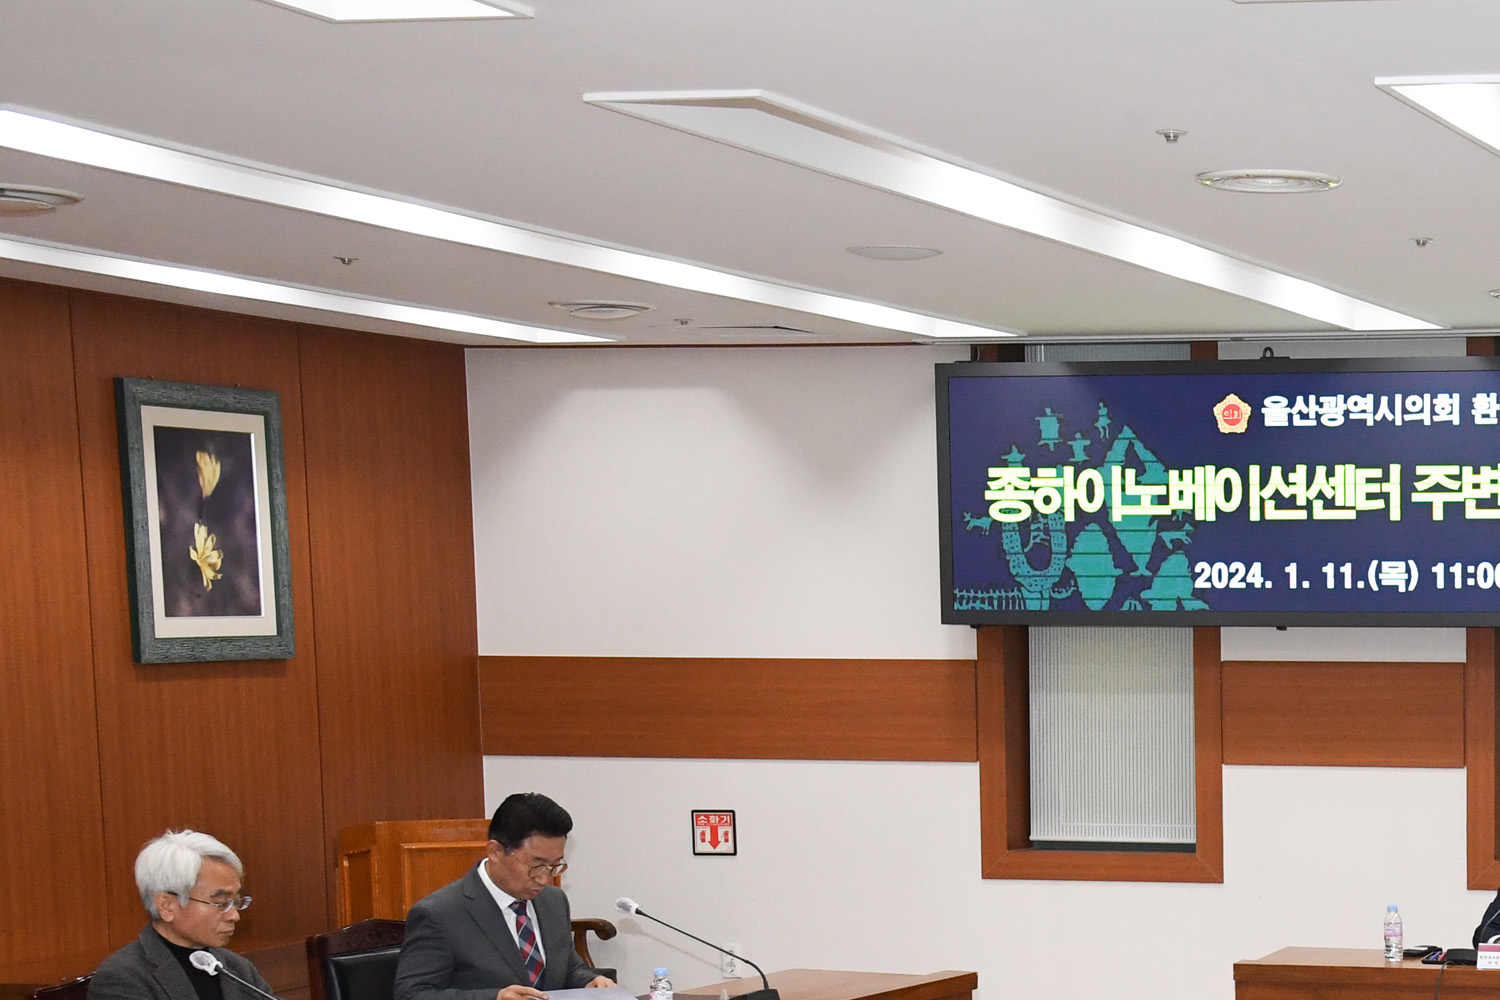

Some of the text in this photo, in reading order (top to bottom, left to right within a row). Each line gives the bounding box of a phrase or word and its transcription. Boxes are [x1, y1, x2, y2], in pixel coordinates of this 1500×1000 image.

[1261, 392, 1460, 427] 울산광역시의회
[984, 464, 1402, 523] 종하이노베이션센터
[1194, 561, 1273, 589] 2024.
[1284, 562, 1310, 589] 1.
[1321, 559, 1419, 593] 11.(목)
